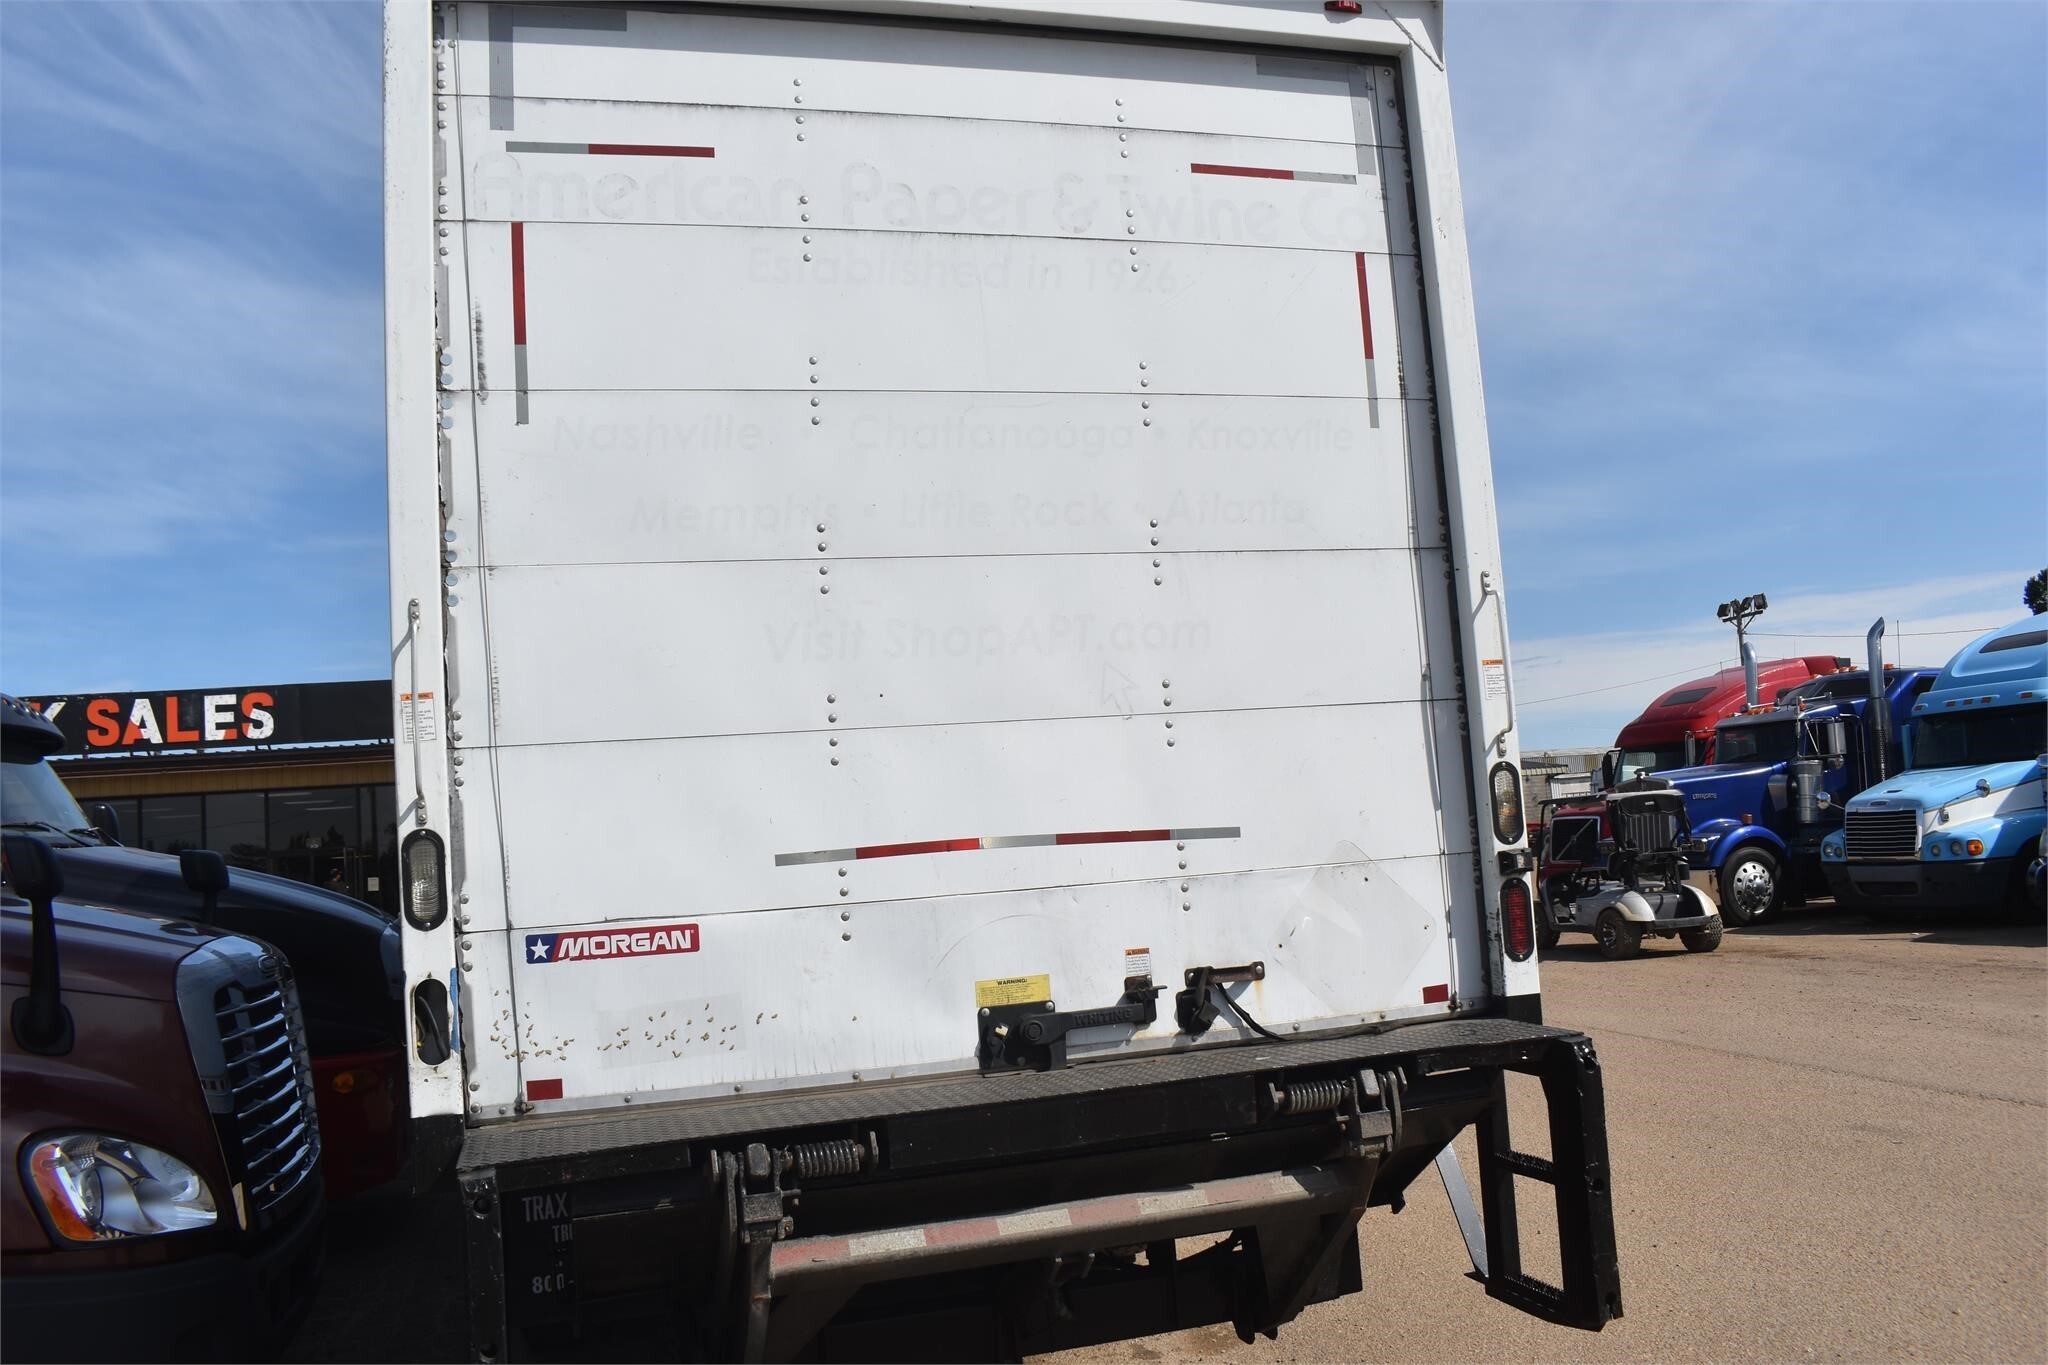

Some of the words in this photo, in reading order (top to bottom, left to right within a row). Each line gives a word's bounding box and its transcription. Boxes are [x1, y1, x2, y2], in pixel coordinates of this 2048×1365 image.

[1027, 255, 1062, 289] in
[554, 414, 764, 453] Nashville
[1187, 418, 1354, 453] Knoxville
[629, 493, 842, 540] Memphis
[1010, 494, 1112, 528] Rock
[1163, 492, 1306, 526] Atlanta
[763, 618, 865, 664] Visit
[884, 613, 1213, 667] ShopAPT.com
[87, 692, 274, 747] SALES
[558, 929, 692, 959] MORGAN
[521, 1192, 568, 1222] TRAX
